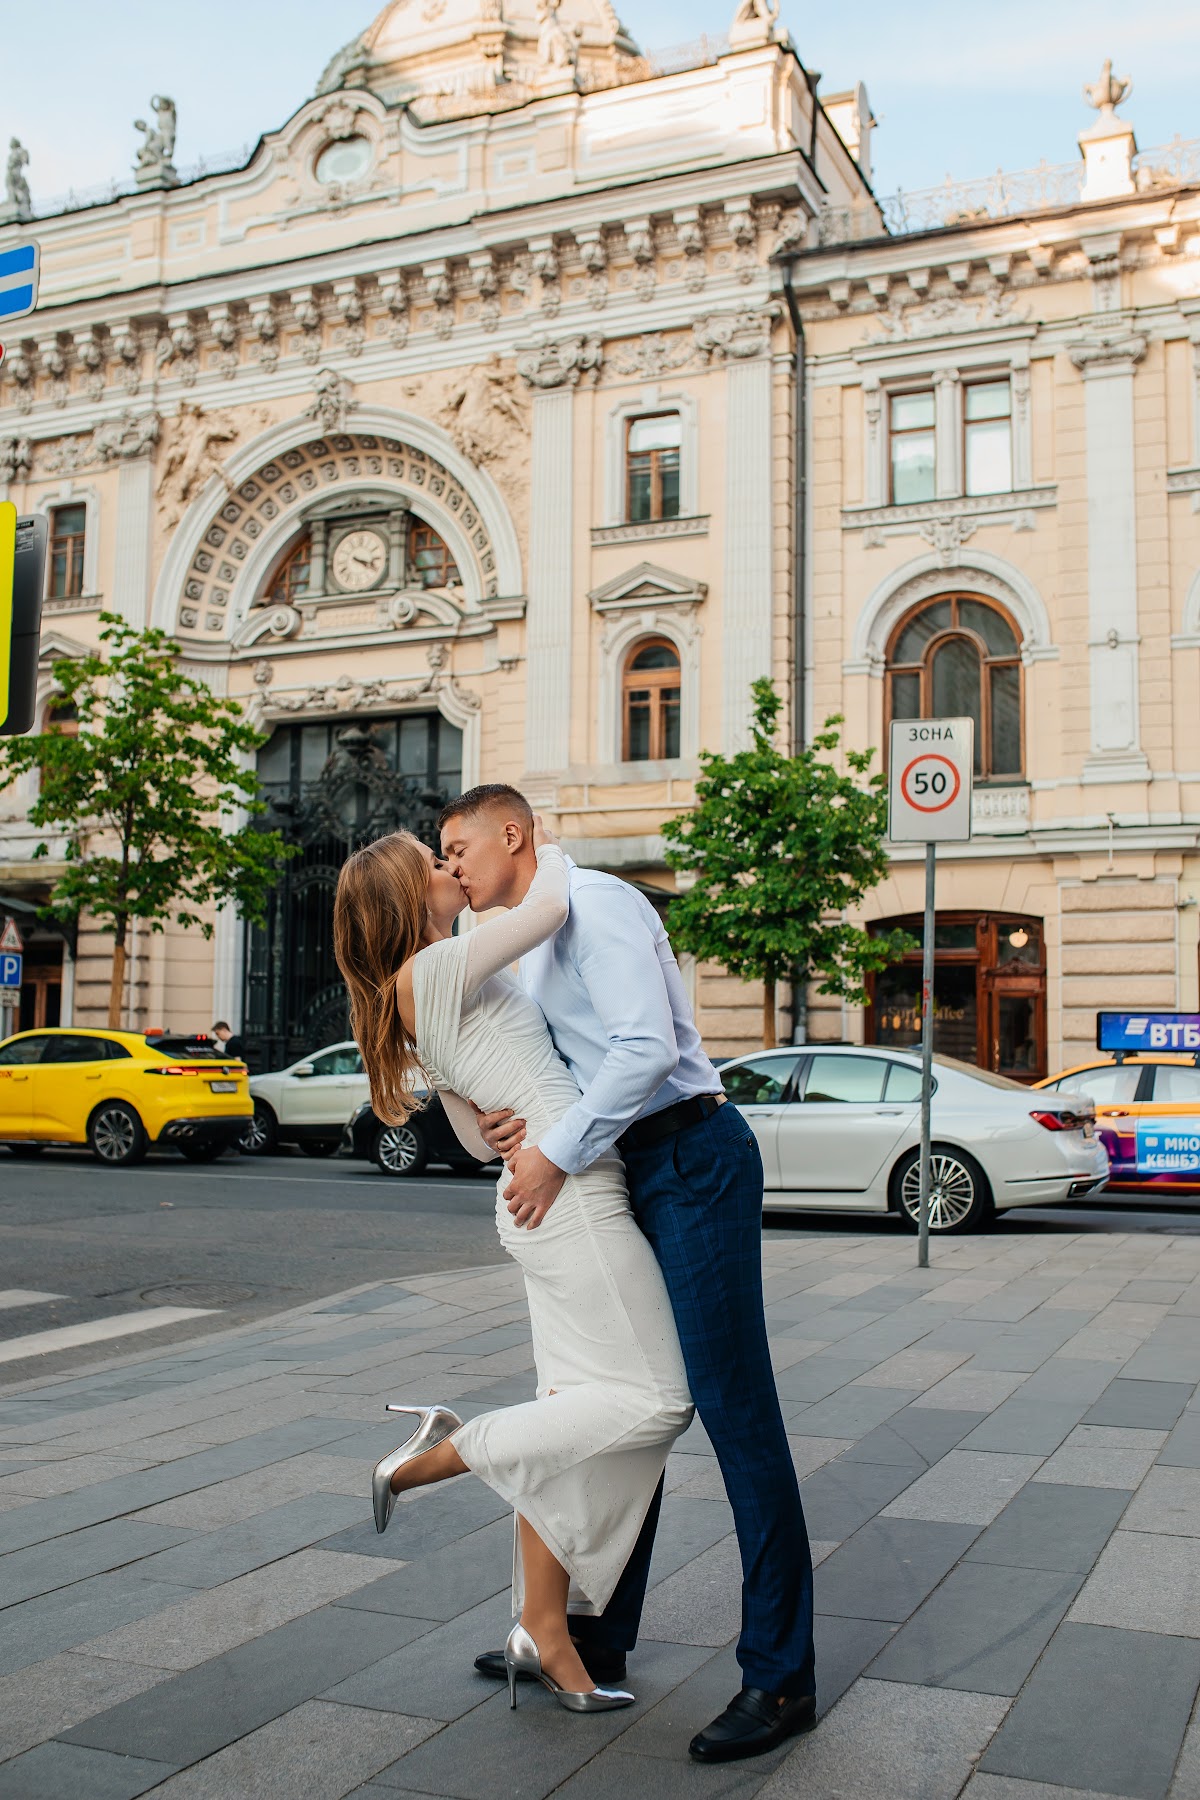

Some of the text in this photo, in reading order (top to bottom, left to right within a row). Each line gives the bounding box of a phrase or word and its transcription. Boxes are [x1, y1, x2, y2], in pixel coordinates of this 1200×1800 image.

[909, 728, 954, 741] ЗОНА
[914, 772, 947, 795] 50
[932, 1004, 965, 1020] offee
[1150, 1023, 1200, 1047] ВТБ
[1164, 1137, 1200, 1151] МНО
[1146, 1153, 1200, 1169] КЕШБЭ
